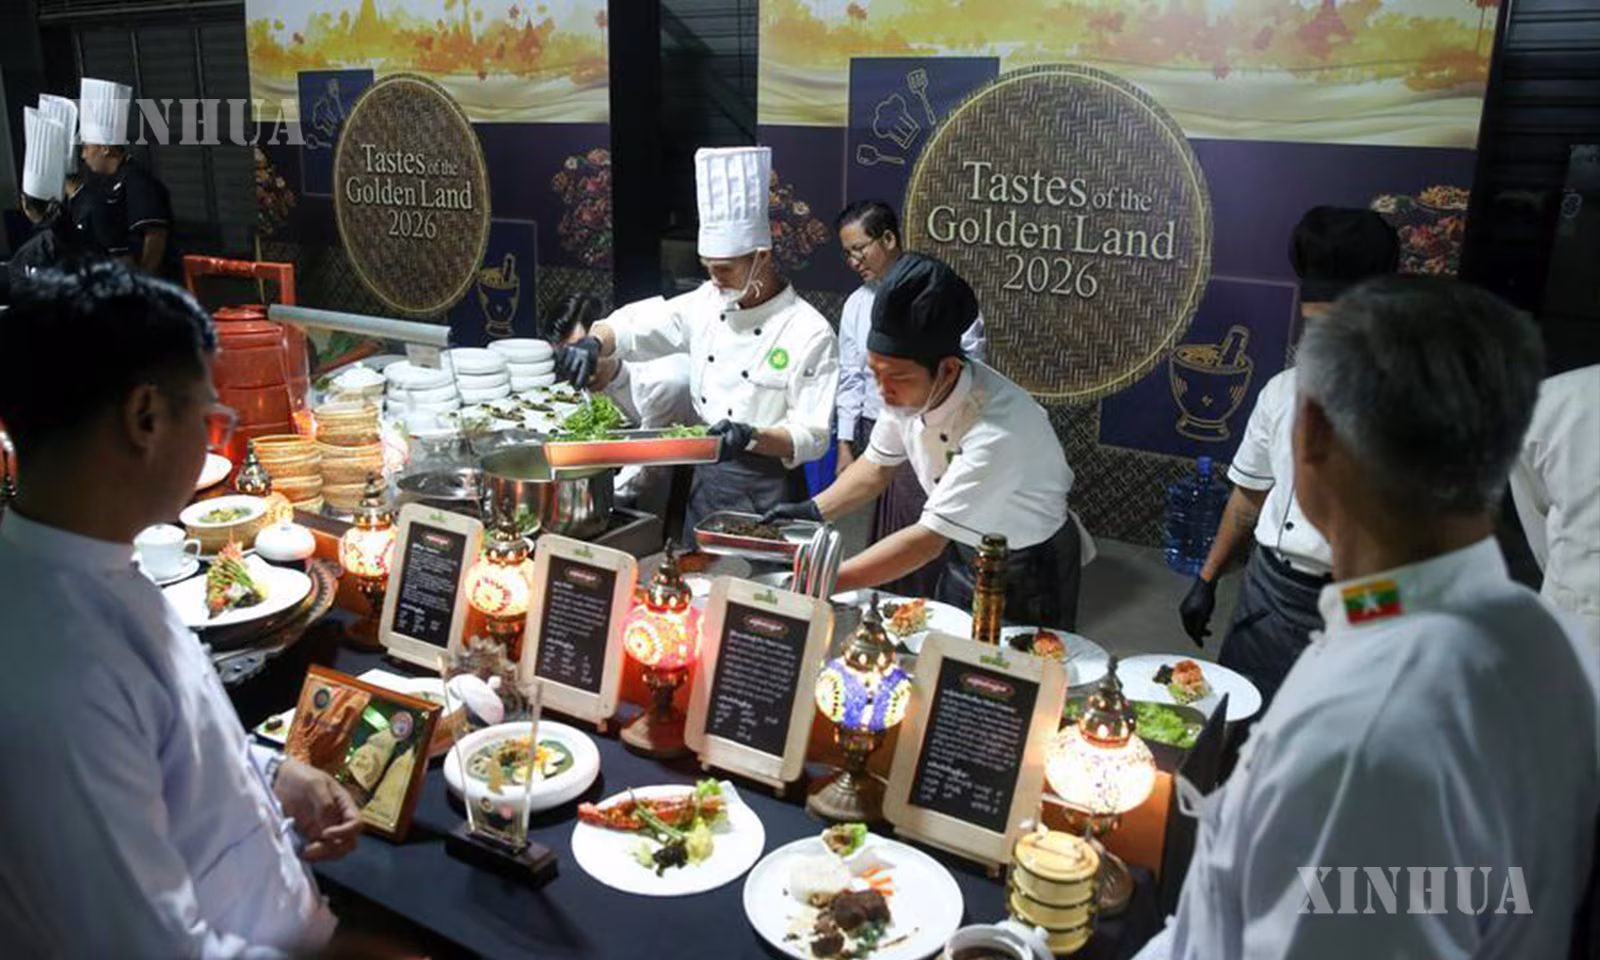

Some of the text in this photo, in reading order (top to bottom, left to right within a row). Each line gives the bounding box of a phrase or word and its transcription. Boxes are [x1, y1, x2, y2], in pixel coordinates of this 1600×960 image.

[361, 144, 426, 174] Tastes
[440, 160, 459, 175] the
[346, 176, 473, 209] Golden Land
[963, 161, 1152, 212] Tastes of the
[387, 209, 437, 239] 2026
[927, 205, 1175, 260] Golden Land
[1003, 254, 1098, 298] 2026
